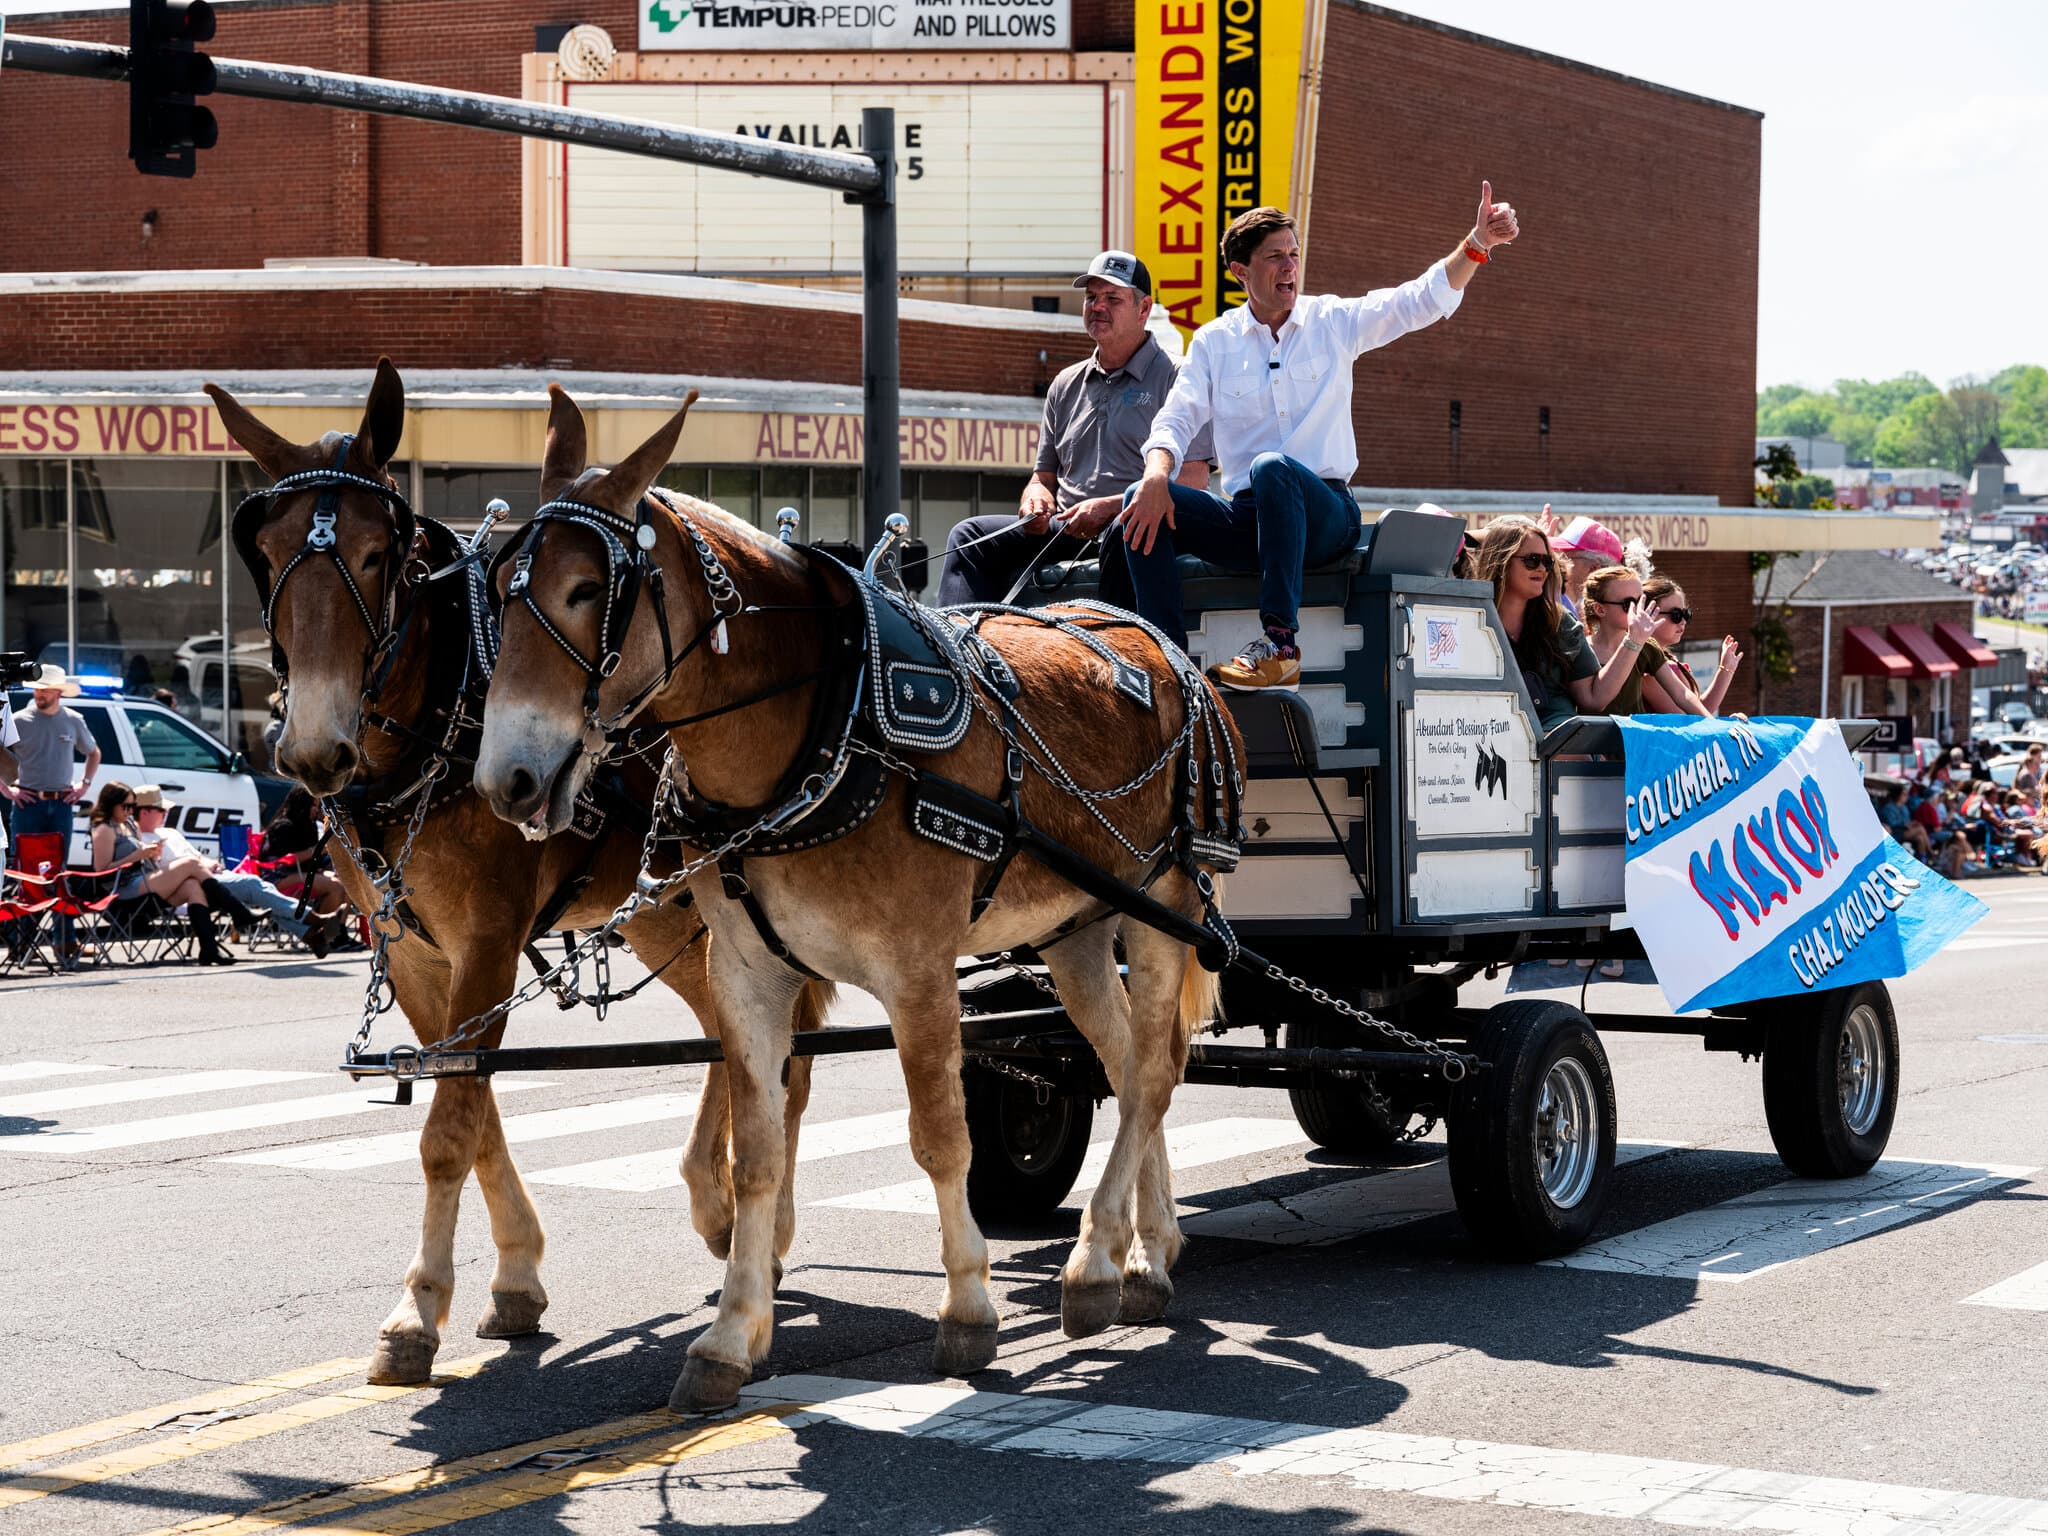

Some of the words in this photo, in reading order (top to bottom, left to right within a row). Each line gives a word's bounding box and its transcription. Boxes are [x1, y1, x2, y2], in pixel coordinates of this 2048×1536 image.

[913, 15, 956, 37] AND
[966, 14, 1056, 37] PILLOWS
[0, 405, 80, 452] ESS
[95, 406, 245, 452] WORL
[756, 413, 947, 463] ALEXANERS
[1656, 516, 1710, 548] WORLD
[1415, 718, 1454, 737] Abundant
[1456, 718, 1488, 744] Blessings
[1489, 719, 1510, 736] Farm
[1427, 742, 1436, 754] For
[1437, 742, 1452, 754] God's
[1452, 742, 1467, 759] Glory
[1625, 740, 1739, 845] COLUMBIA,
[1729, 726, 1764, 766] TN
[1689, 774, 1839, 941] MAYOR
[1789, 921, 1844, 987] CHAZ
[1840, 862, 1921, 947] MOLDER
